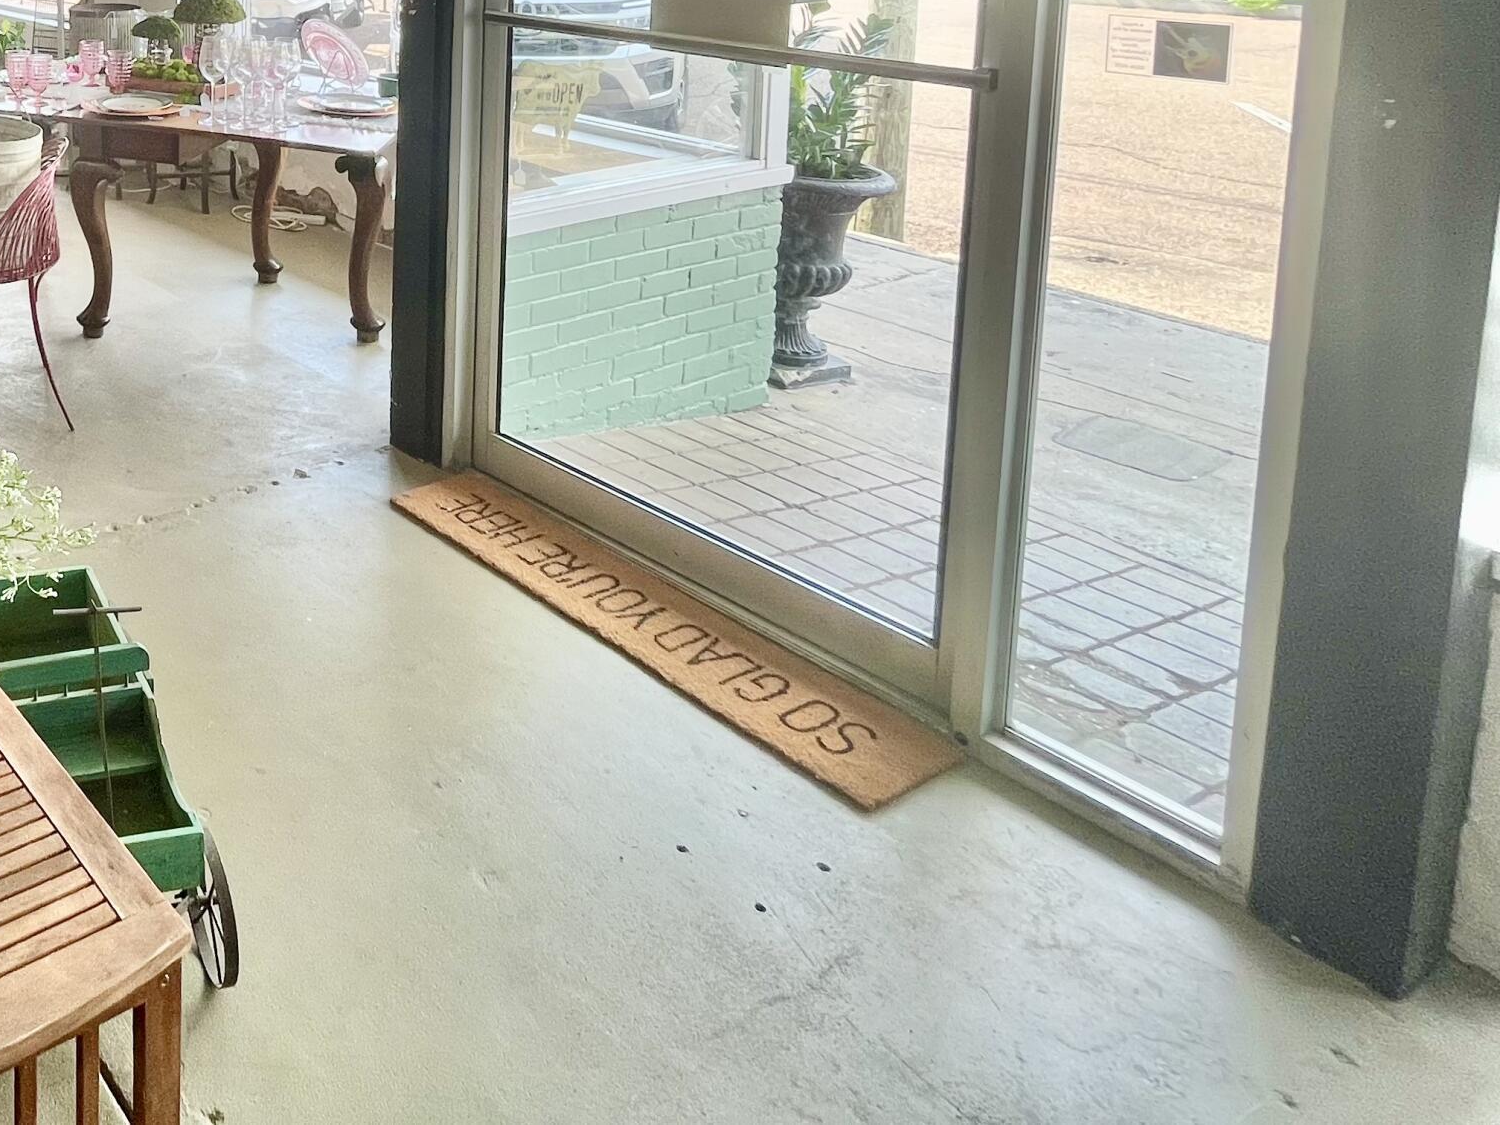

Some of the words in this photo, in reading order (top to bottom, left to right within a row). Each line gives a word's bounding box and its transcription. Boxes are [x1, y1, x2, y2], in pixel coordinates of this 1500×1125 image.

[551, 82, 585, 105] OPEN
[439, 491, 542, 550] HERE
[516, 540, 668, 632] YOU'RE
[653, 622, 792, 704] GLAD
[777, 698, 879, 756] SO
